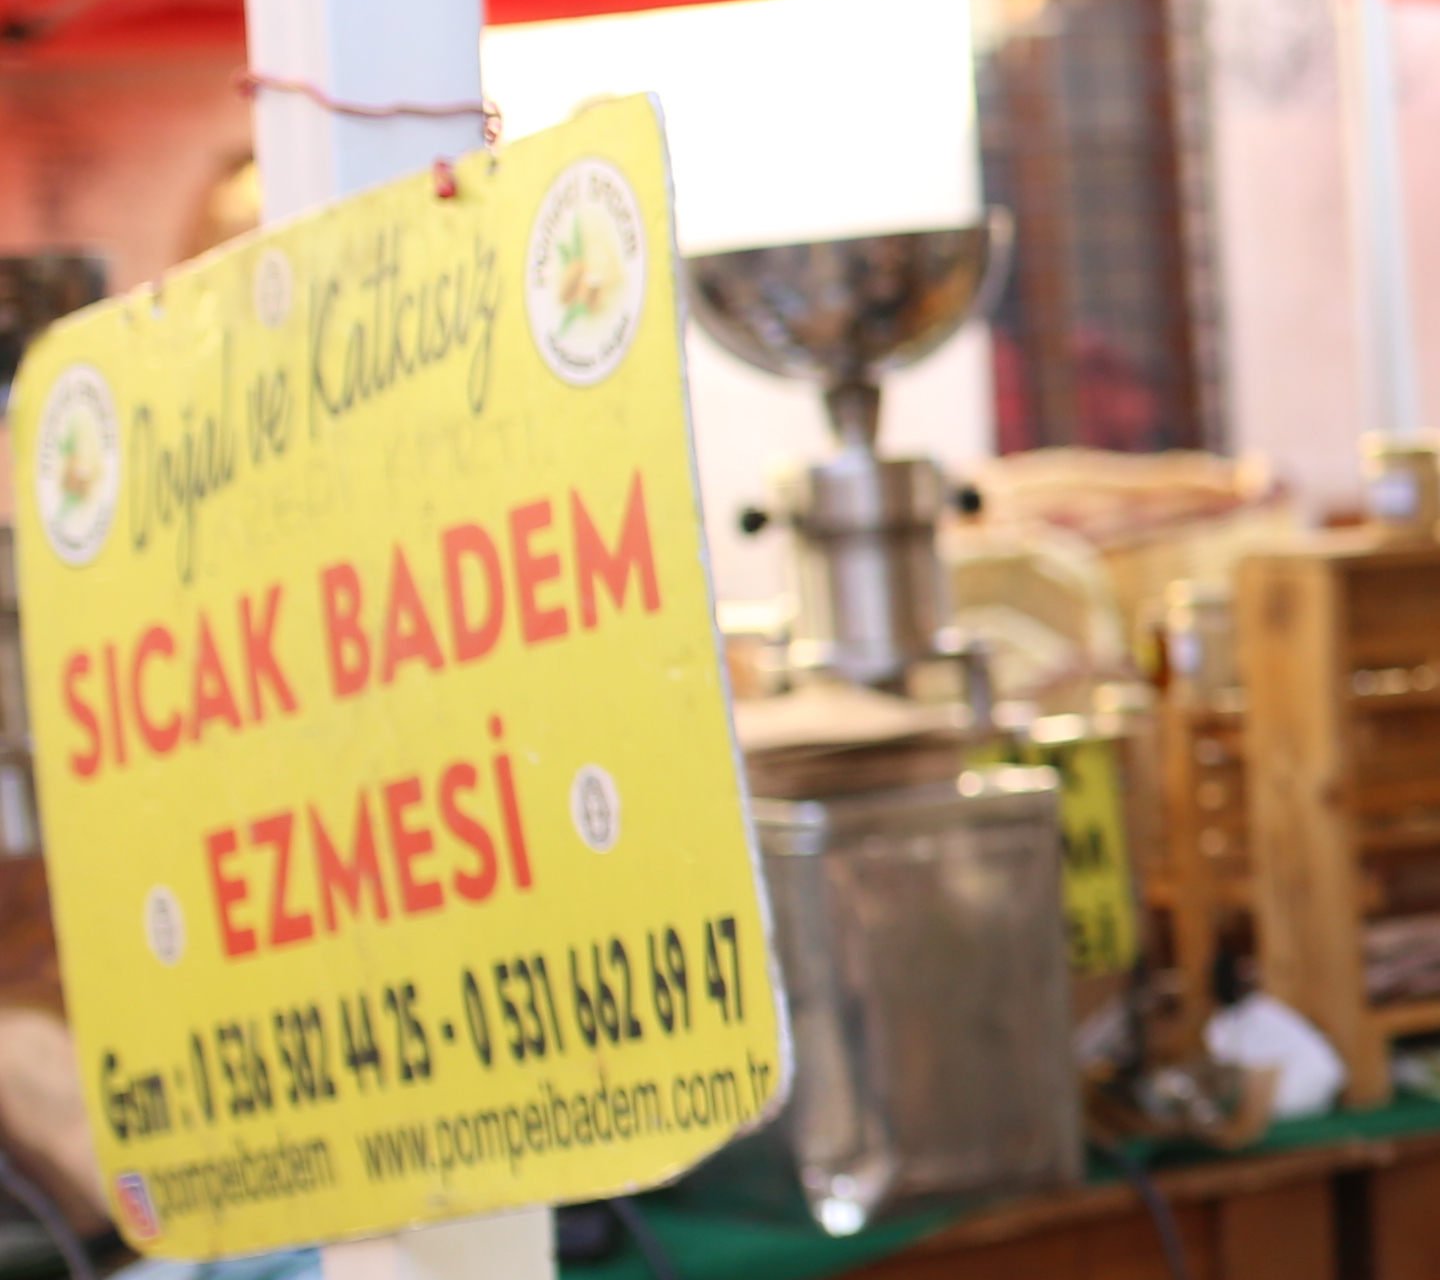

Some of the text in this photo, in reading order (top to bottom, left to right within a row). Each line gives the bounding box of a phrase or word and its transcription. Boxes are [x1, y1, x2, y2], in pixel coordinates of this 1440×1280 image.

[129, 325, 236, 586] Doğal
[247, 360, 290, 464] ve
[308, 224, 501, 437] Katkısız
[61, 581, 298, 781] SICAK
[318, 468, 662, 701] BADEM
[203, 713, 533, 964] EZMESİ
[100, 1050, 170, 1141] Gsm
[191, 1030, 215, 1122] 0
[216, 1022, 273, 1116] 536
[273, 1005, 337, 1105] 582
[339, 994, 387, 1093] 44
[385, 983, 432, 1082] 25
[461, 968, 493, 1068] 0
[494, 955, 563, 1062] 531
[570, 937, 642, 1047] 662
[648, 926, 690, 1033] 69
[705, 916, 743, 1026] 47
[357, 1048, 770, 1186] www.pompeibadem.com.tr
